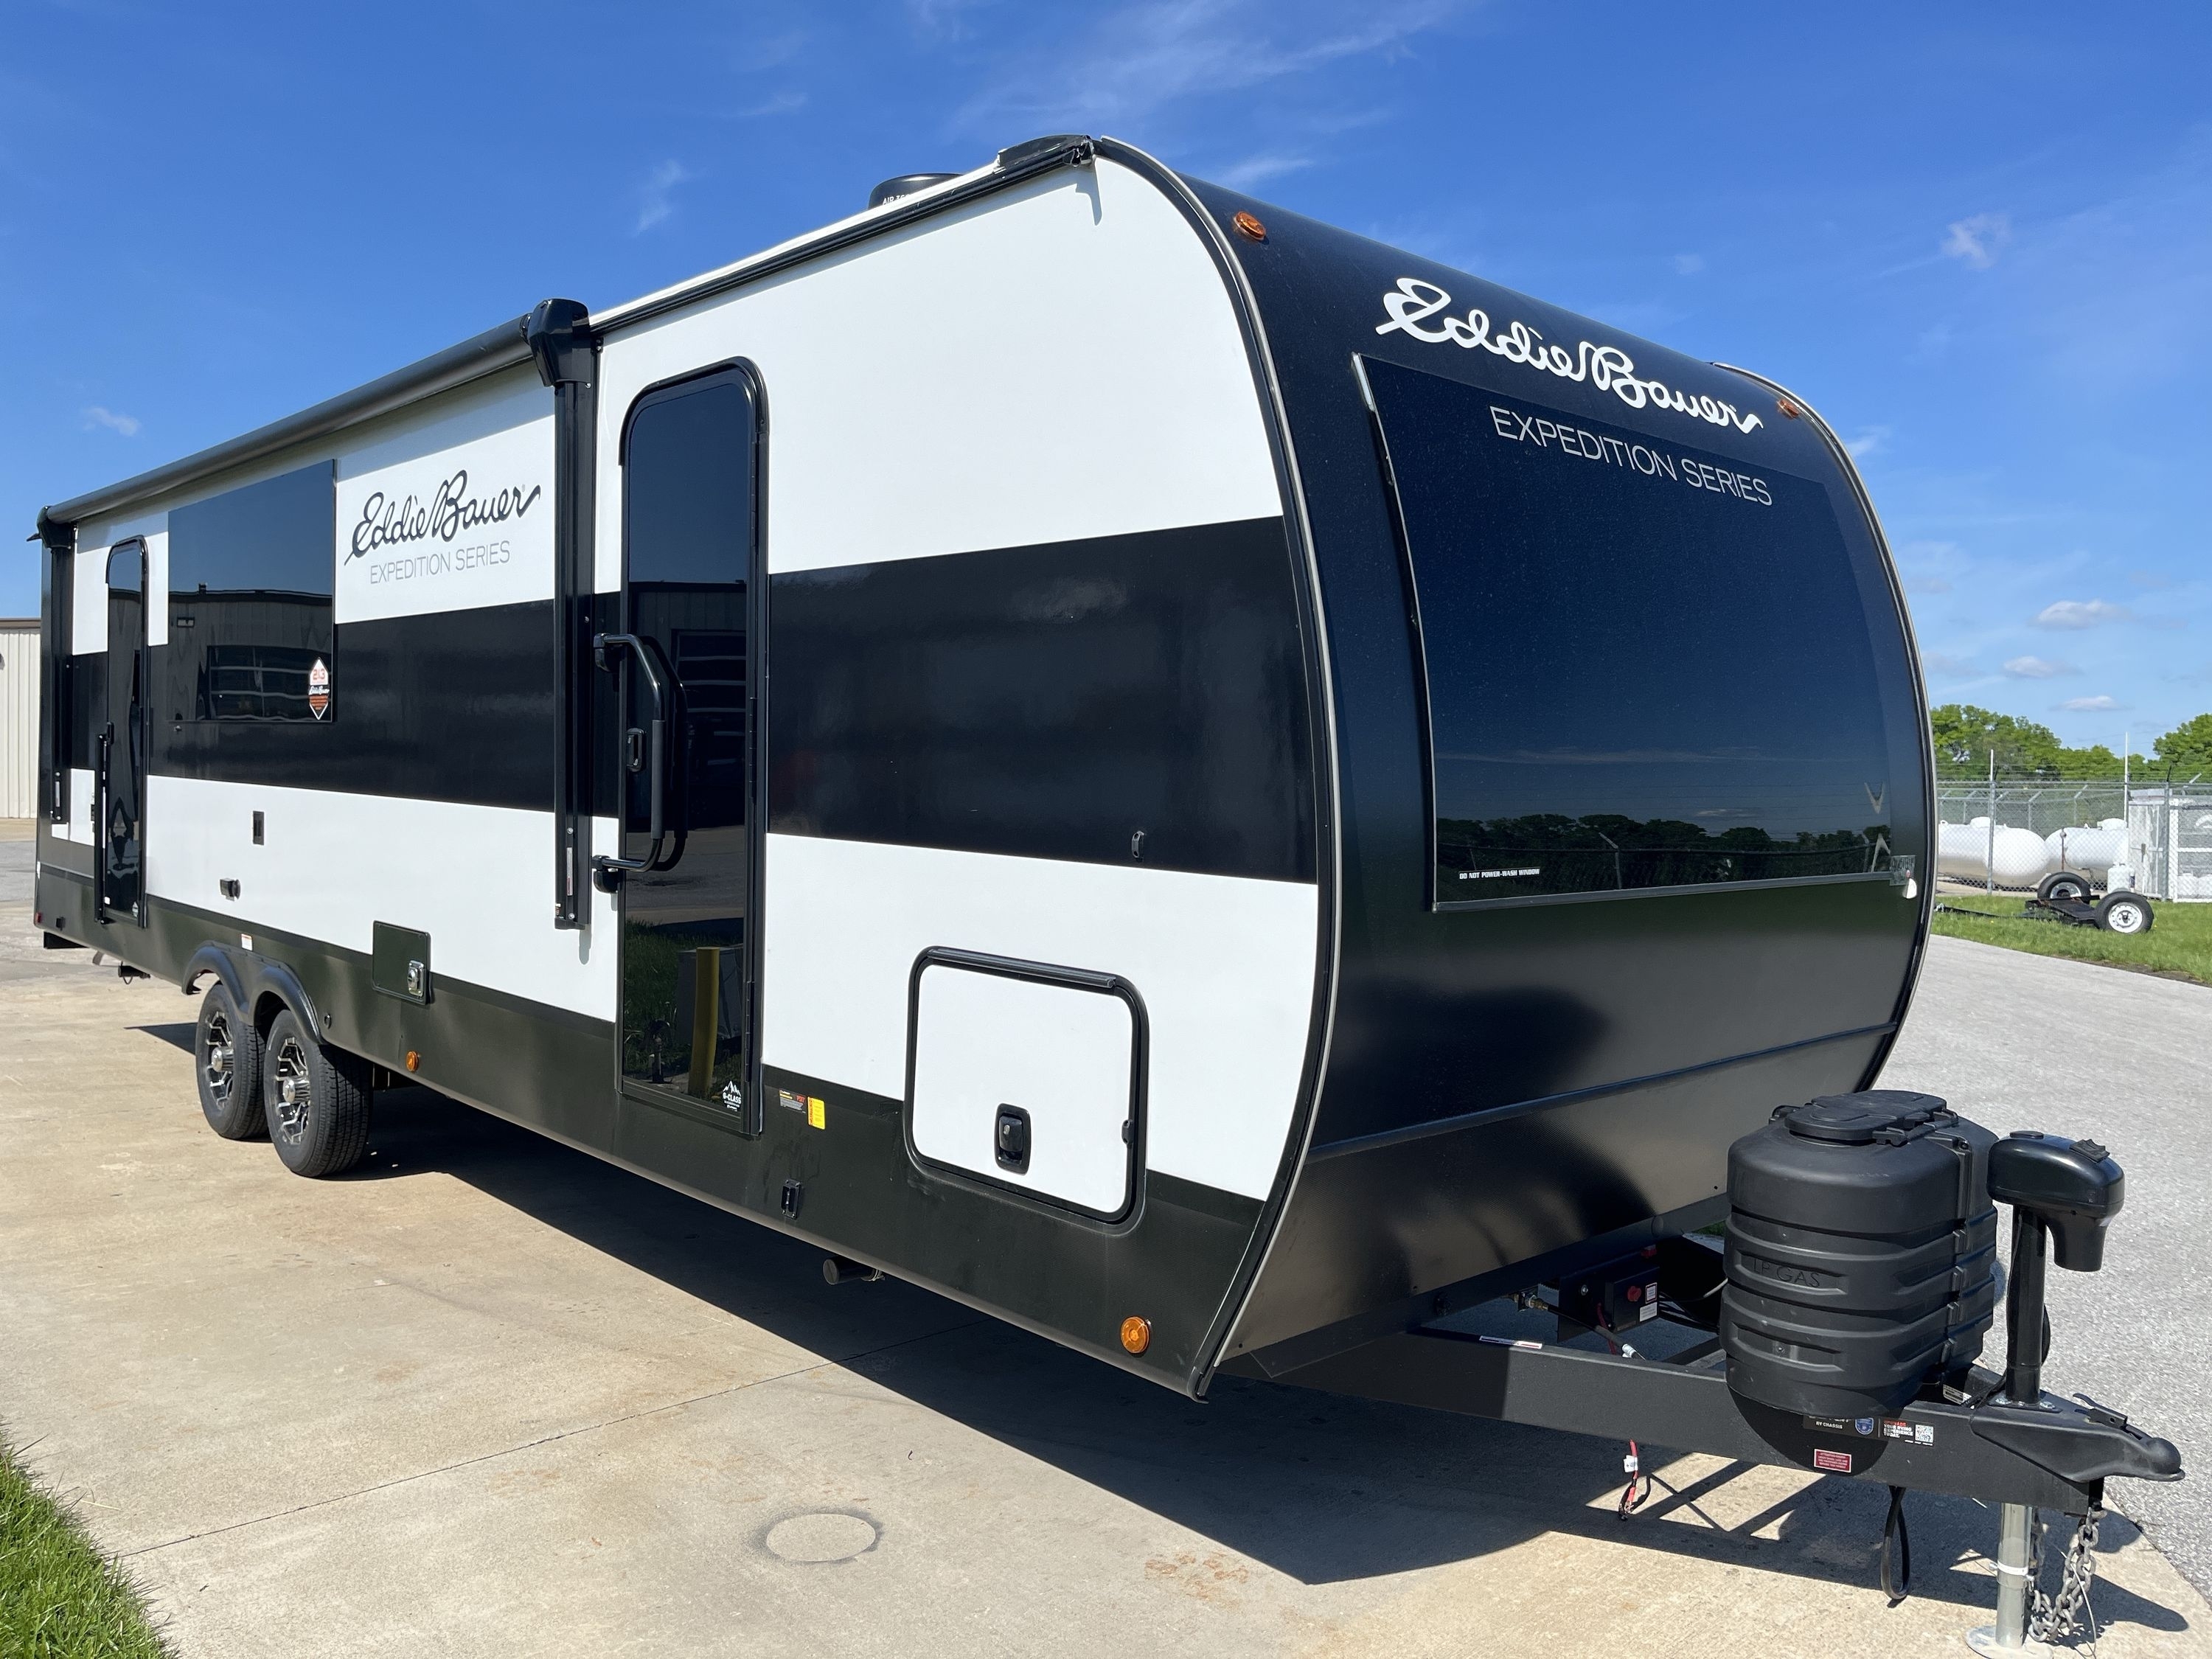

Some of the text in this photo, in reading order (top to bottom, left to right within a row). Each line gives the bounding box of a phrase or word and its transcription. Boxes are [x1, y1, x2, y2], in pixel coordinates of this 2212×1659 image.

[1375, 278, 1764, 434] Eddie Bauer
[1489, 406, 1773, 507] EXPEDITION SERIES
[344, 470, 541, 566] Eddie Bauer
[370, 540, 510, 584] EXPEDITION SERIES
[1481, 869, 1517, 878] POWER-WASH
[1519, 868, 1540, 876] WINDOW
[1777, 1266, 1820, 1287] GAS
